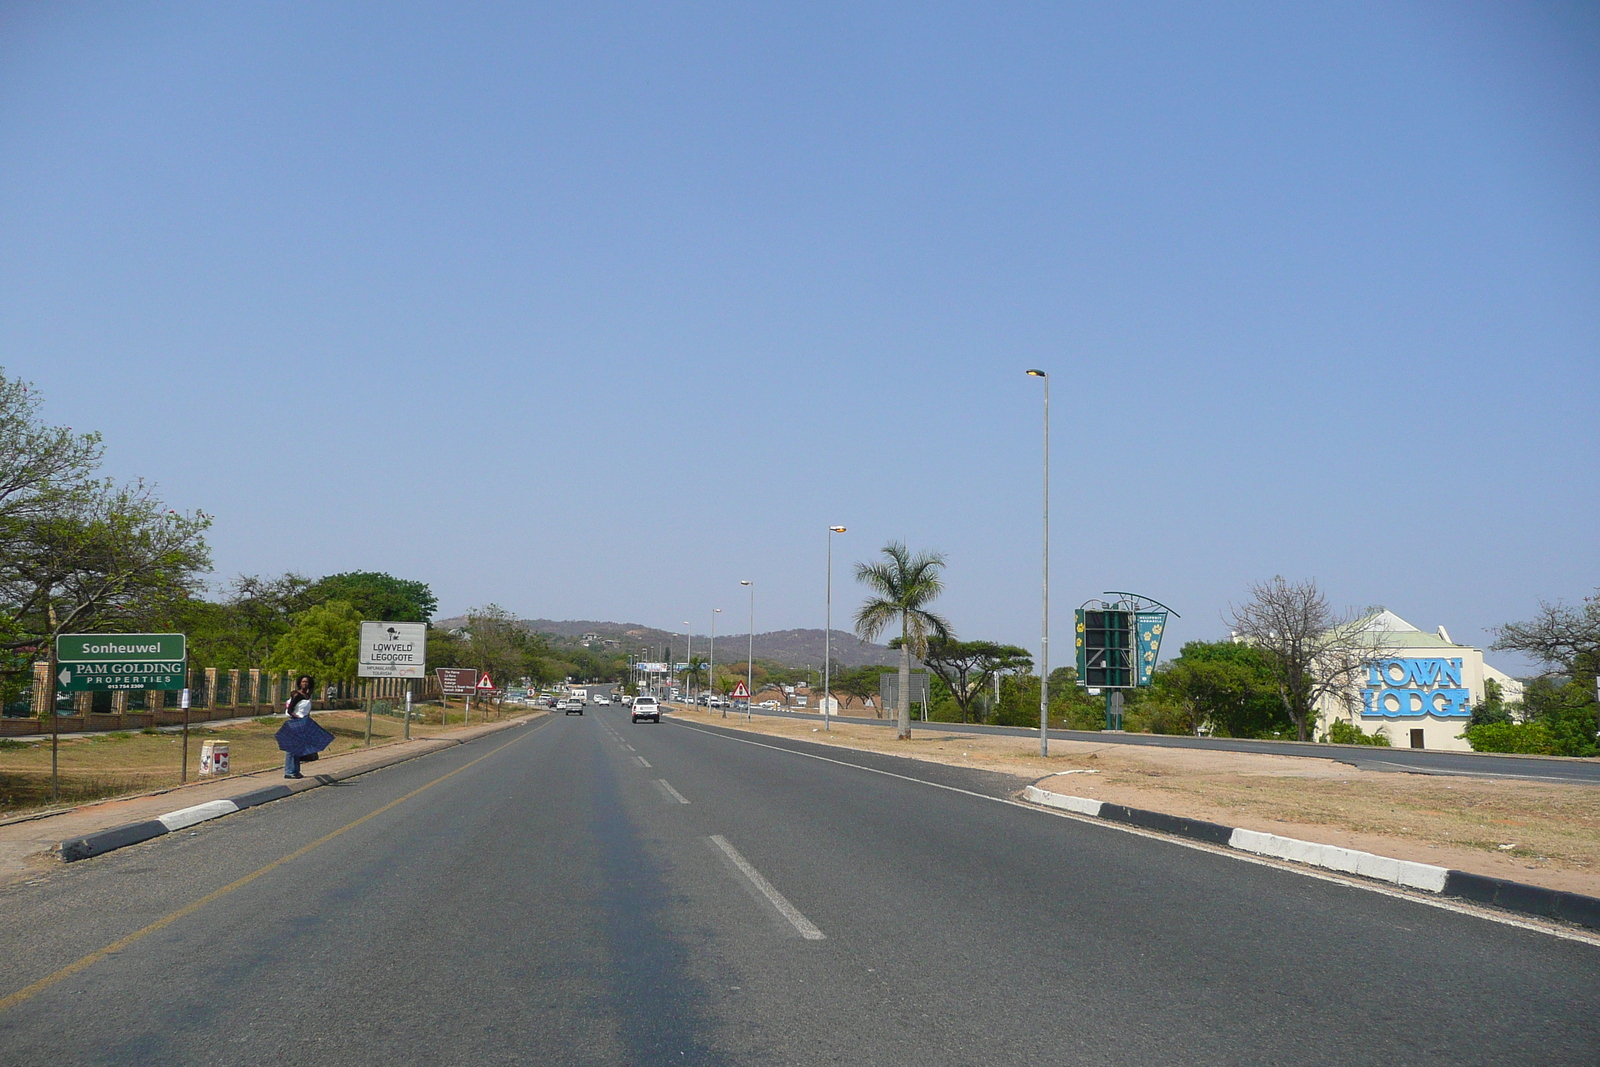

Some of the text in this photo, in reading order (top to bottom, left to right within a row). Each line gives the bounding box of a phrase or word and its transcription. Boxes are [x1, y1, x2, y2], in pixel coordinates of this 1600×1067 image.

[82, 642, 161, 654] Sonheuwel
[373, 643, 413, 652] LOWVELD
[371, 653, 413, 662] LEGOGOTE
[76, 663, 182, 674] PAM GOLDING
[1360, 657, 1463, 687] TOWN
[86, 676, 171, 684] PROPERTIES
[1360, 688, 1472, 717] LODGE
